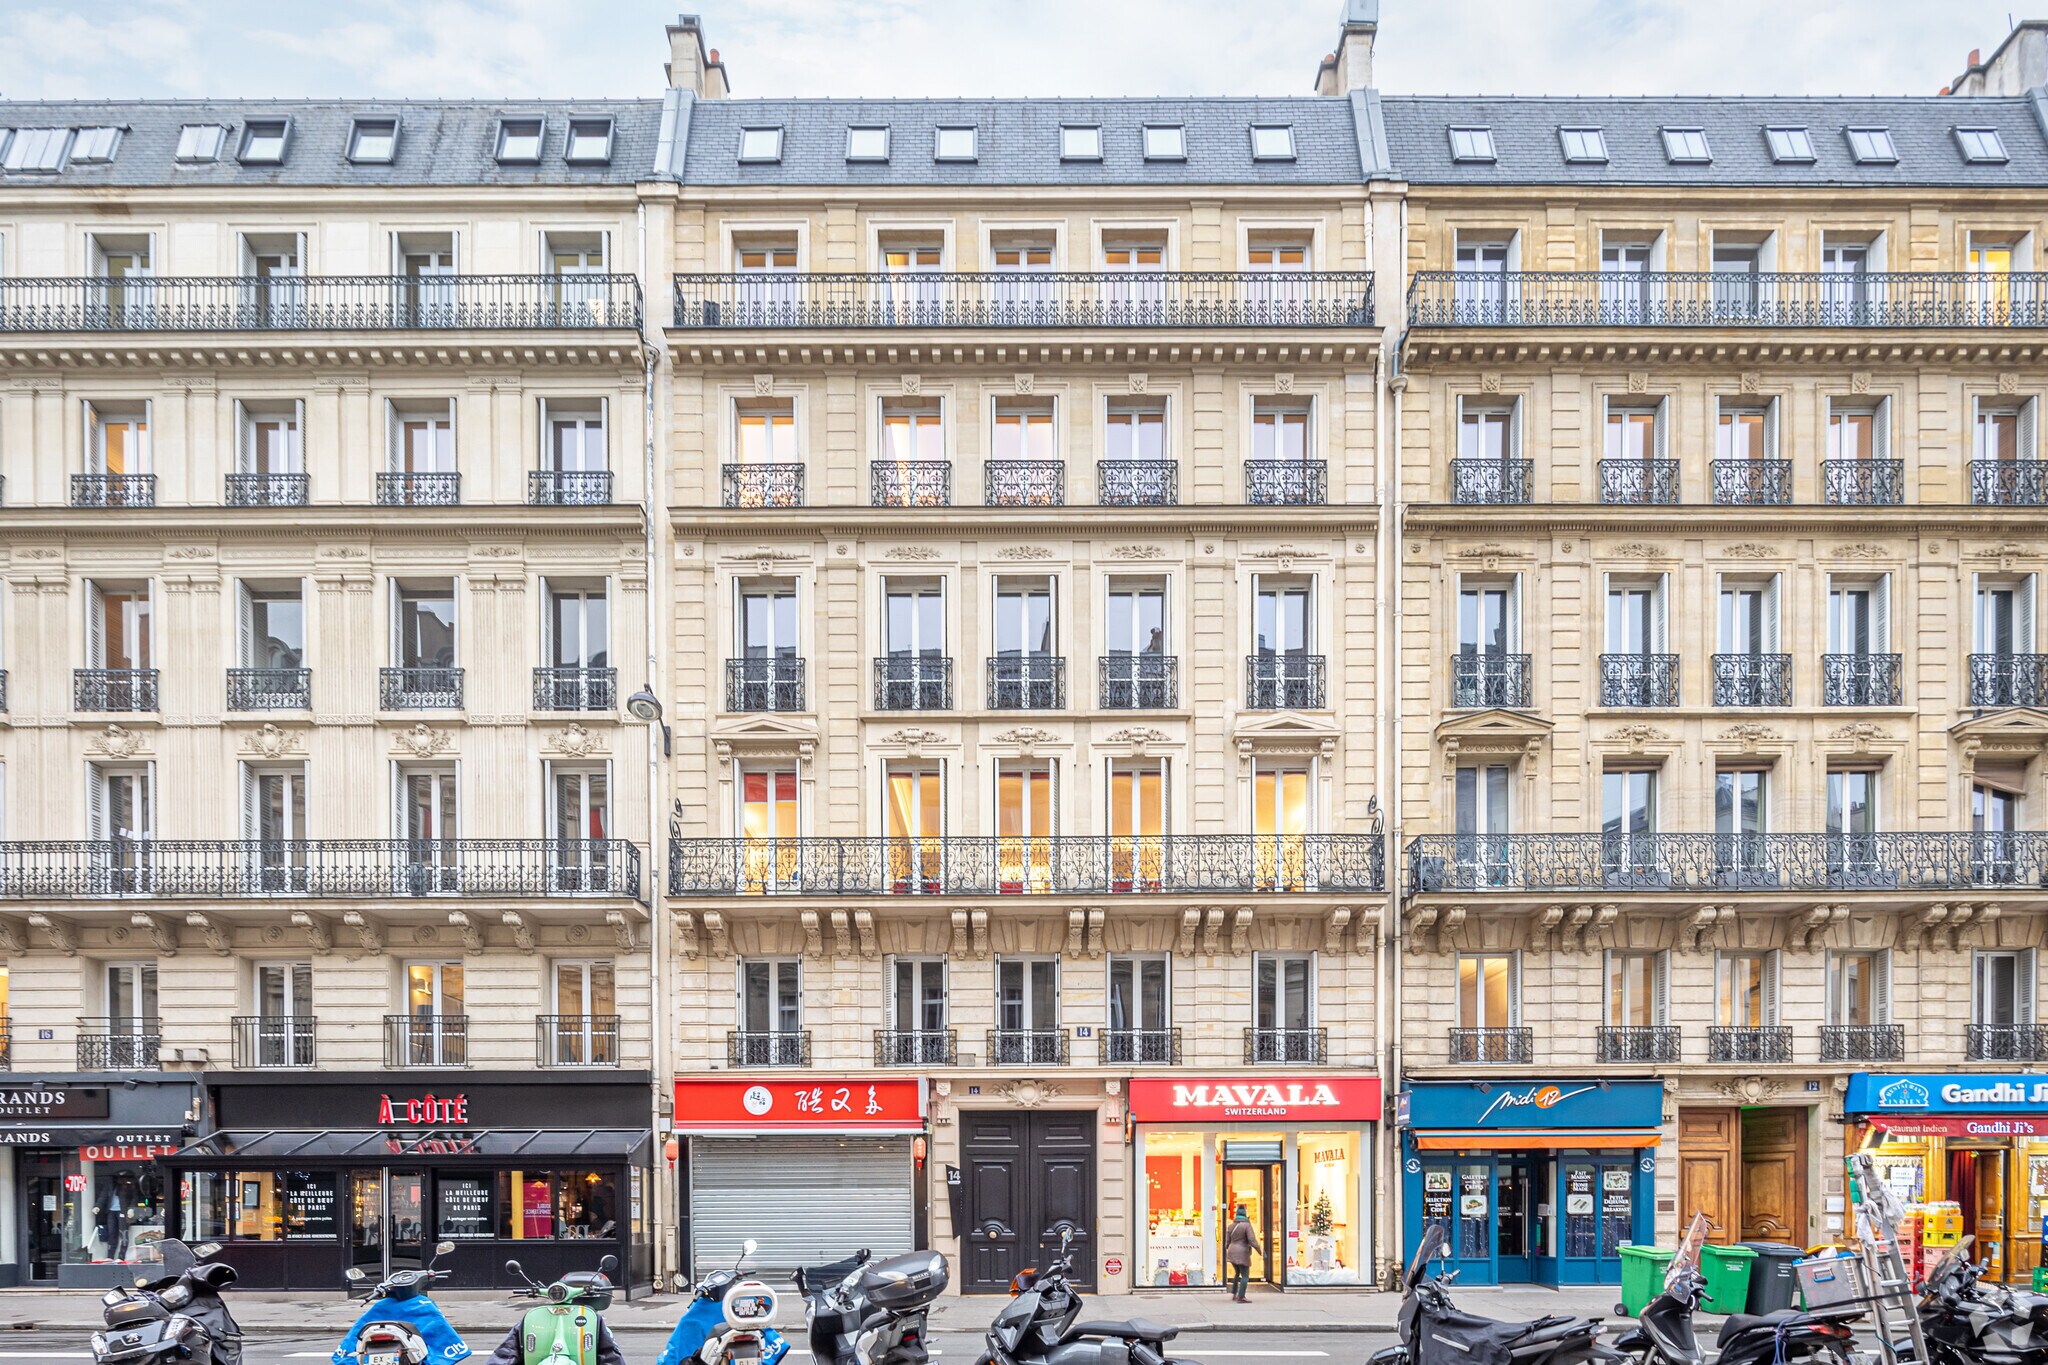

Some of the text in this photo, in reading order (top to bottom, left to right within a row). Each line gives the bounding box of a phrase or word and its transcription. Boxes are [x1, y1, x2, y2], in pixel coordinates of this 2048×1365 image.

[41, 1029, 52, 1040] 16
[1079, 1027, 1089, 1037] 14
[970, 1087, 979, 1095] 14
[1808, 1081, 1819, 1091] 12
[1885, 1083, 1925, 1097] RESTAURANT
[1172, 1084, 1341, 1107] MAVALA
[1941, 1082, 2026, 1103] Gandhi
[378, 1093, 468, 1124] À CÔTÉ
[1224, 1107, 1287, 1116] SWITZERLAND
[1922, 1123, 1948, 1133] Indien
[1966, 1121, 2035, 1134] Gandhi Ji's
[116, 1134, 171, 1143] OUTLET
[86, 1146, 171, 1159] OUTLET
[1313, 1147, 1346, 1164] MAVALA
[947, 1170, 961, 1181] 14
[65, 1175, 87, 1192] -70%
